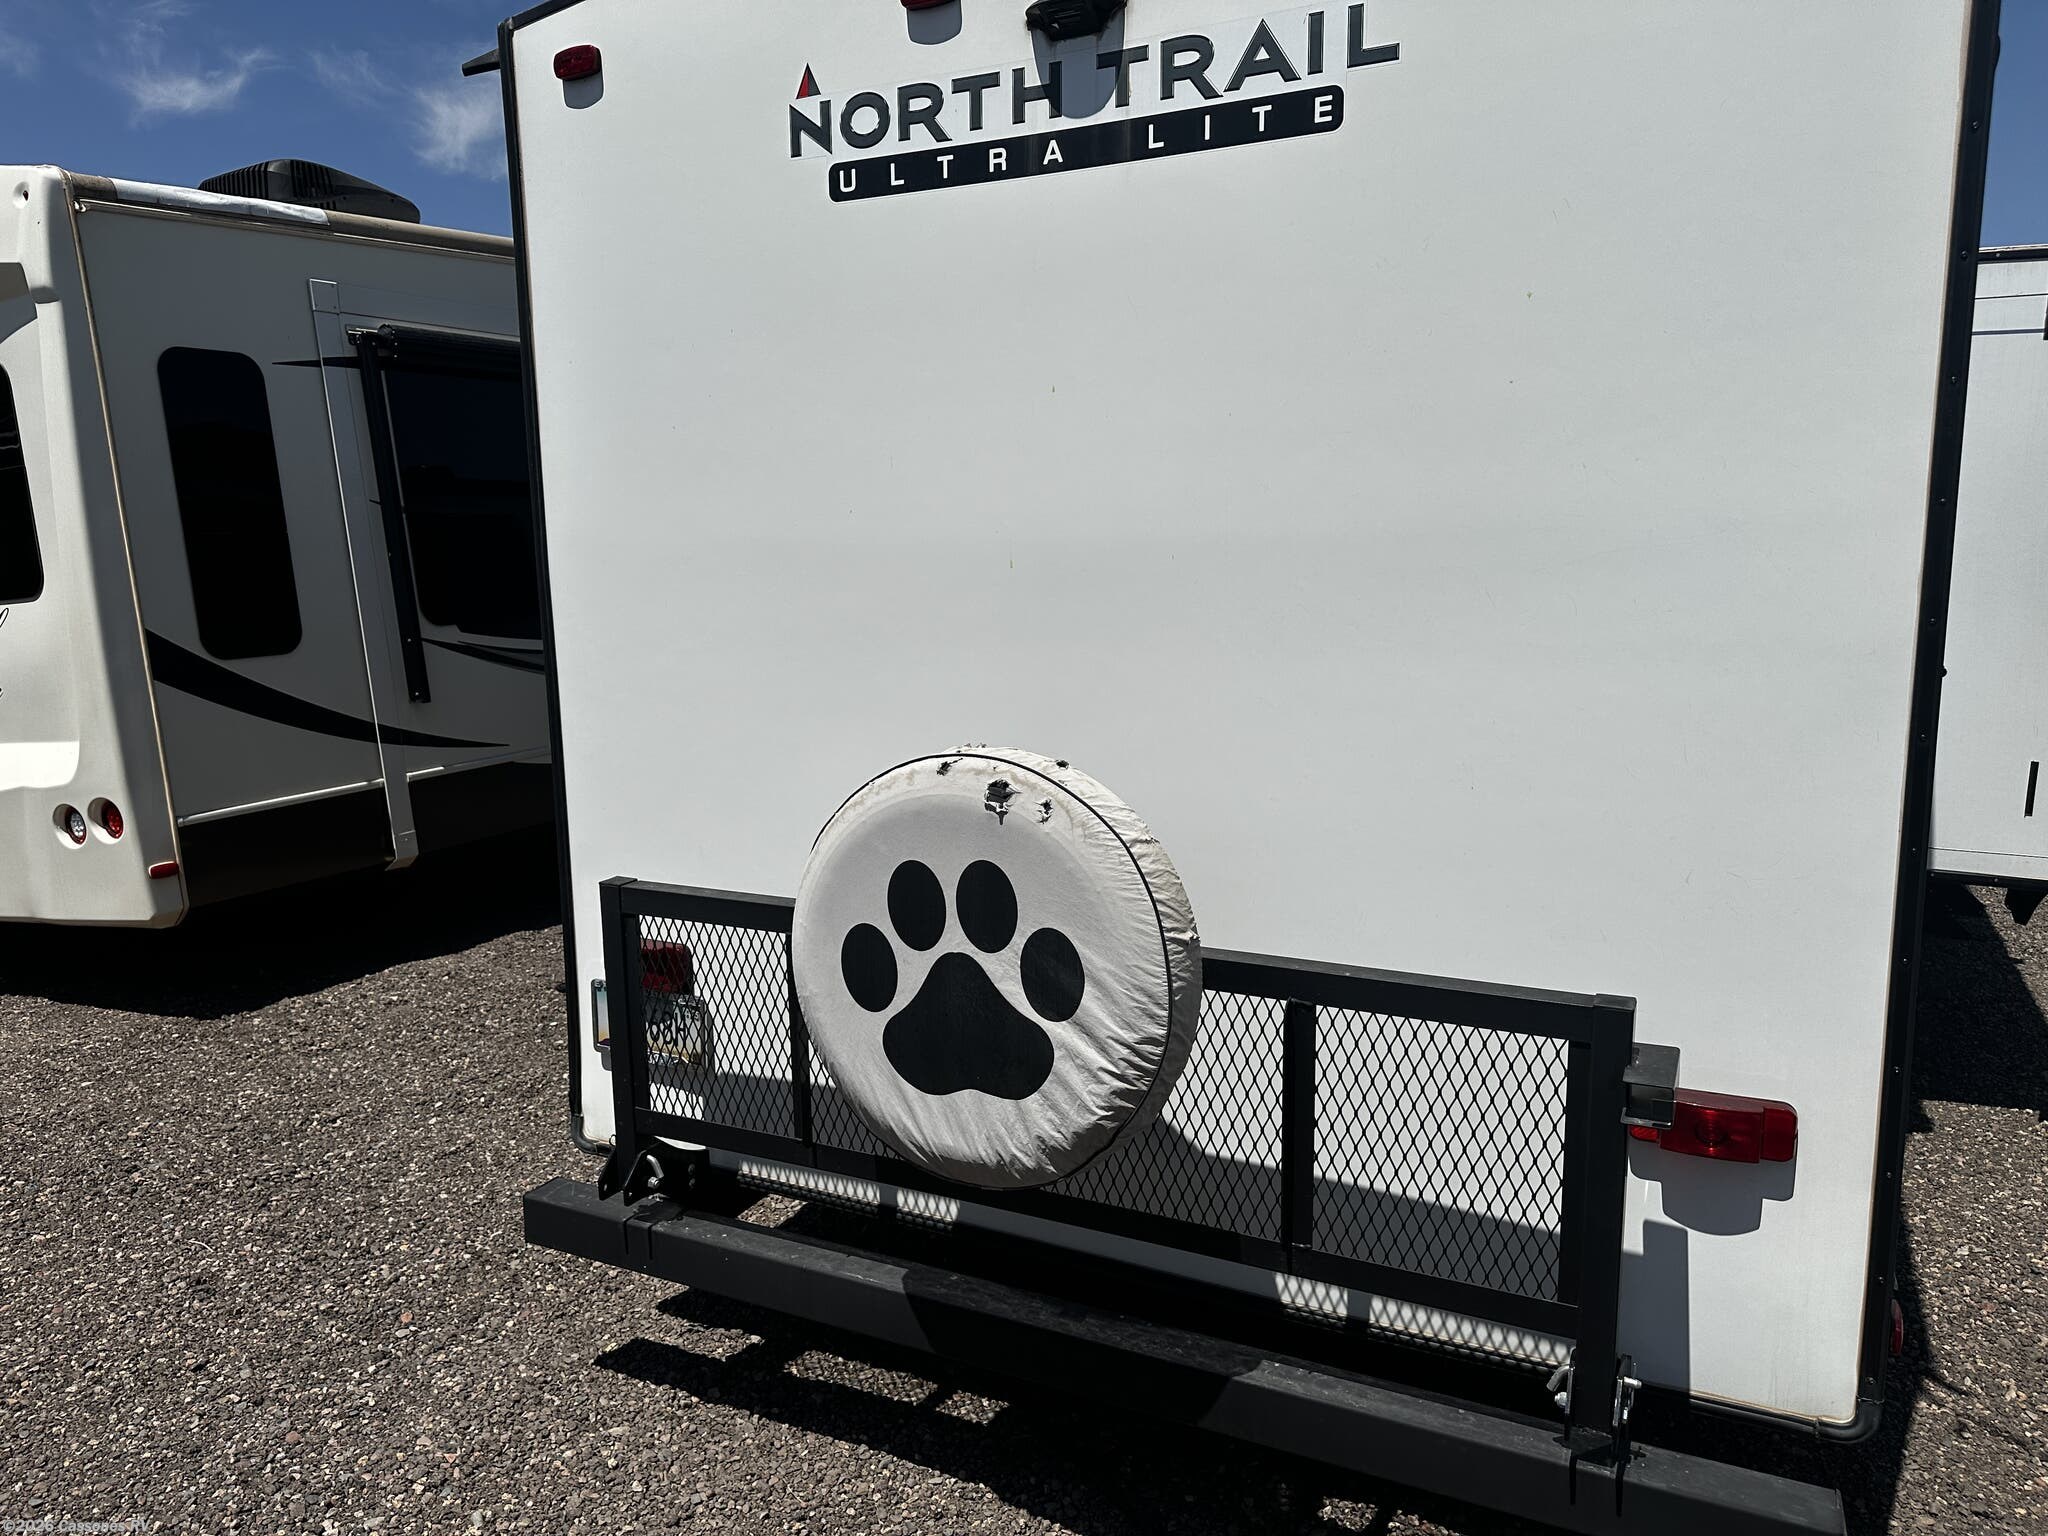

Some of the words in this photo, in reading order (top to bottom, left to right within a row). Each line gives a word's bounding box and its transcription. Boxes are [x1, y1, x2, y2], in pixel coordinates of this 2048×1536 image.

[790, 62, 1063, 157] NORTH
[1096, 4, 1400, 107] TRAIL
[839, 139, 1064, 193] ULTRA
[1148, 95, 1333, 149] LITE
